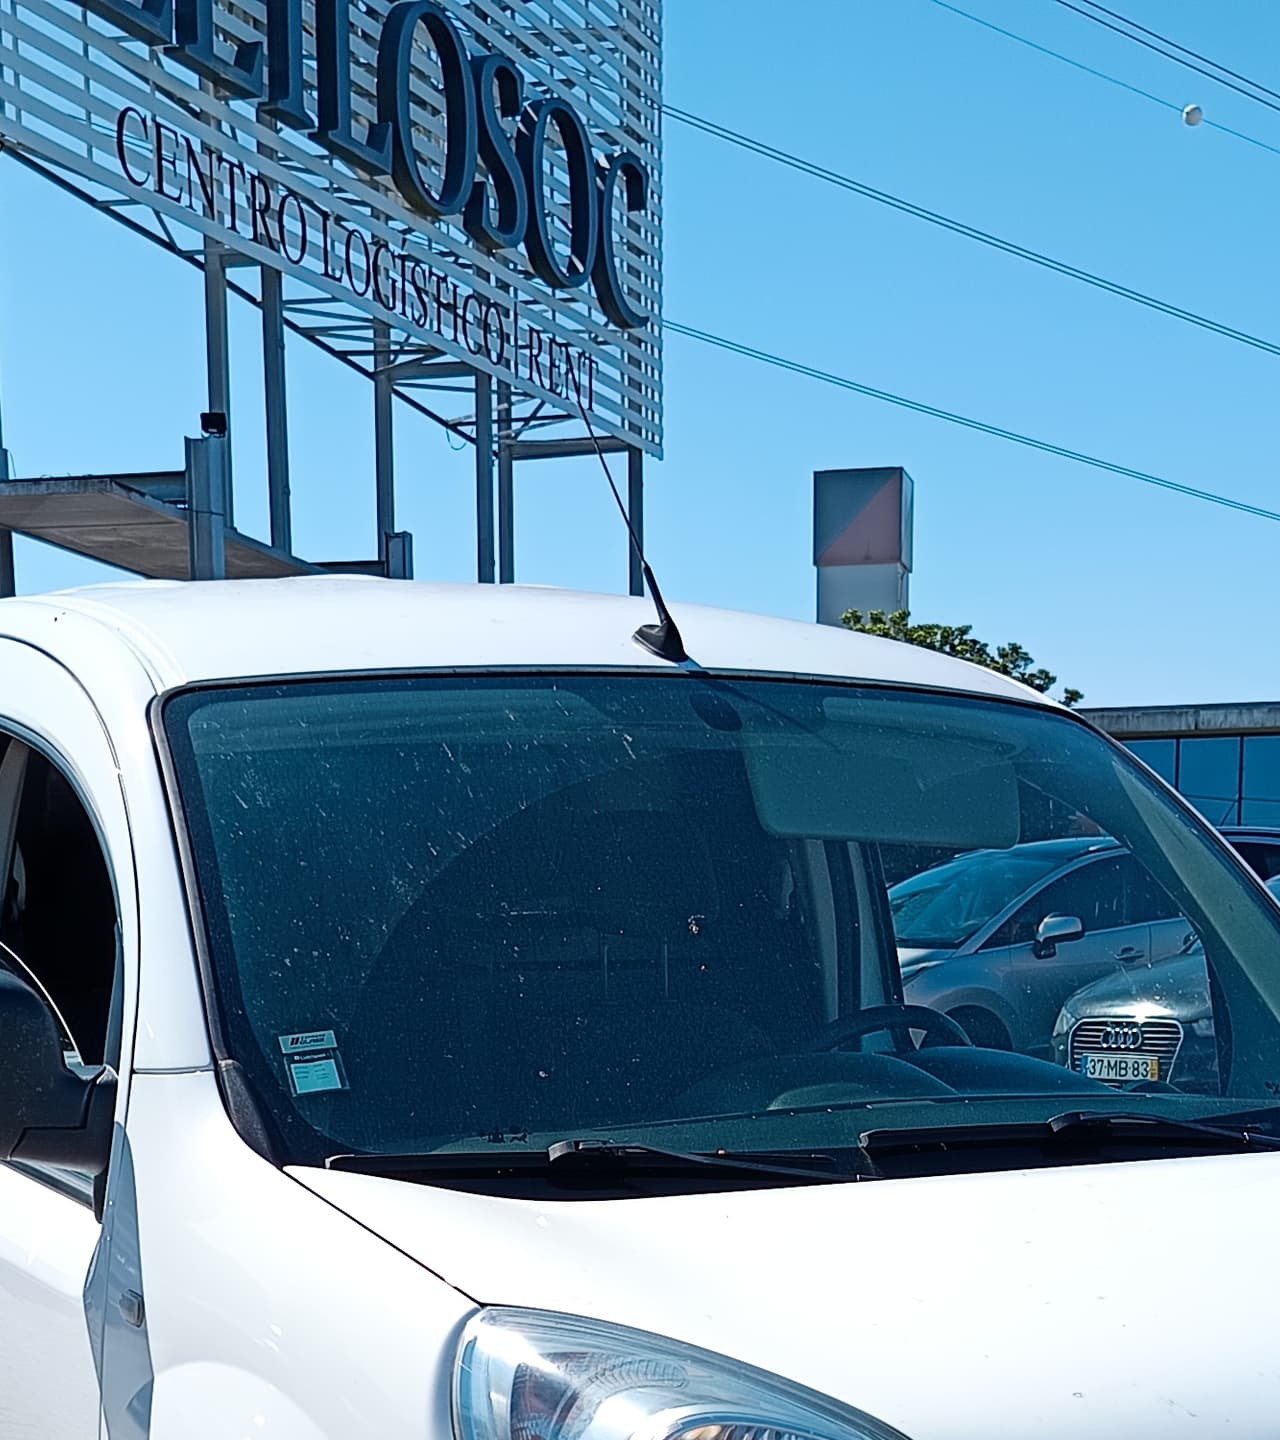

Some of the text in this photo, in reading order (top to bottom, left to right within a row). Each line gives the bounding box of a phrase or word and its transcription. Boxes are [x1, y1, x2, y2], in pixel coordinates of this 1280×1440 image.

[75, 0, 650, 329] ILOSOC
[116, 106, 308, 265] CENTRO
[527, 324, 600, 412] RENT
